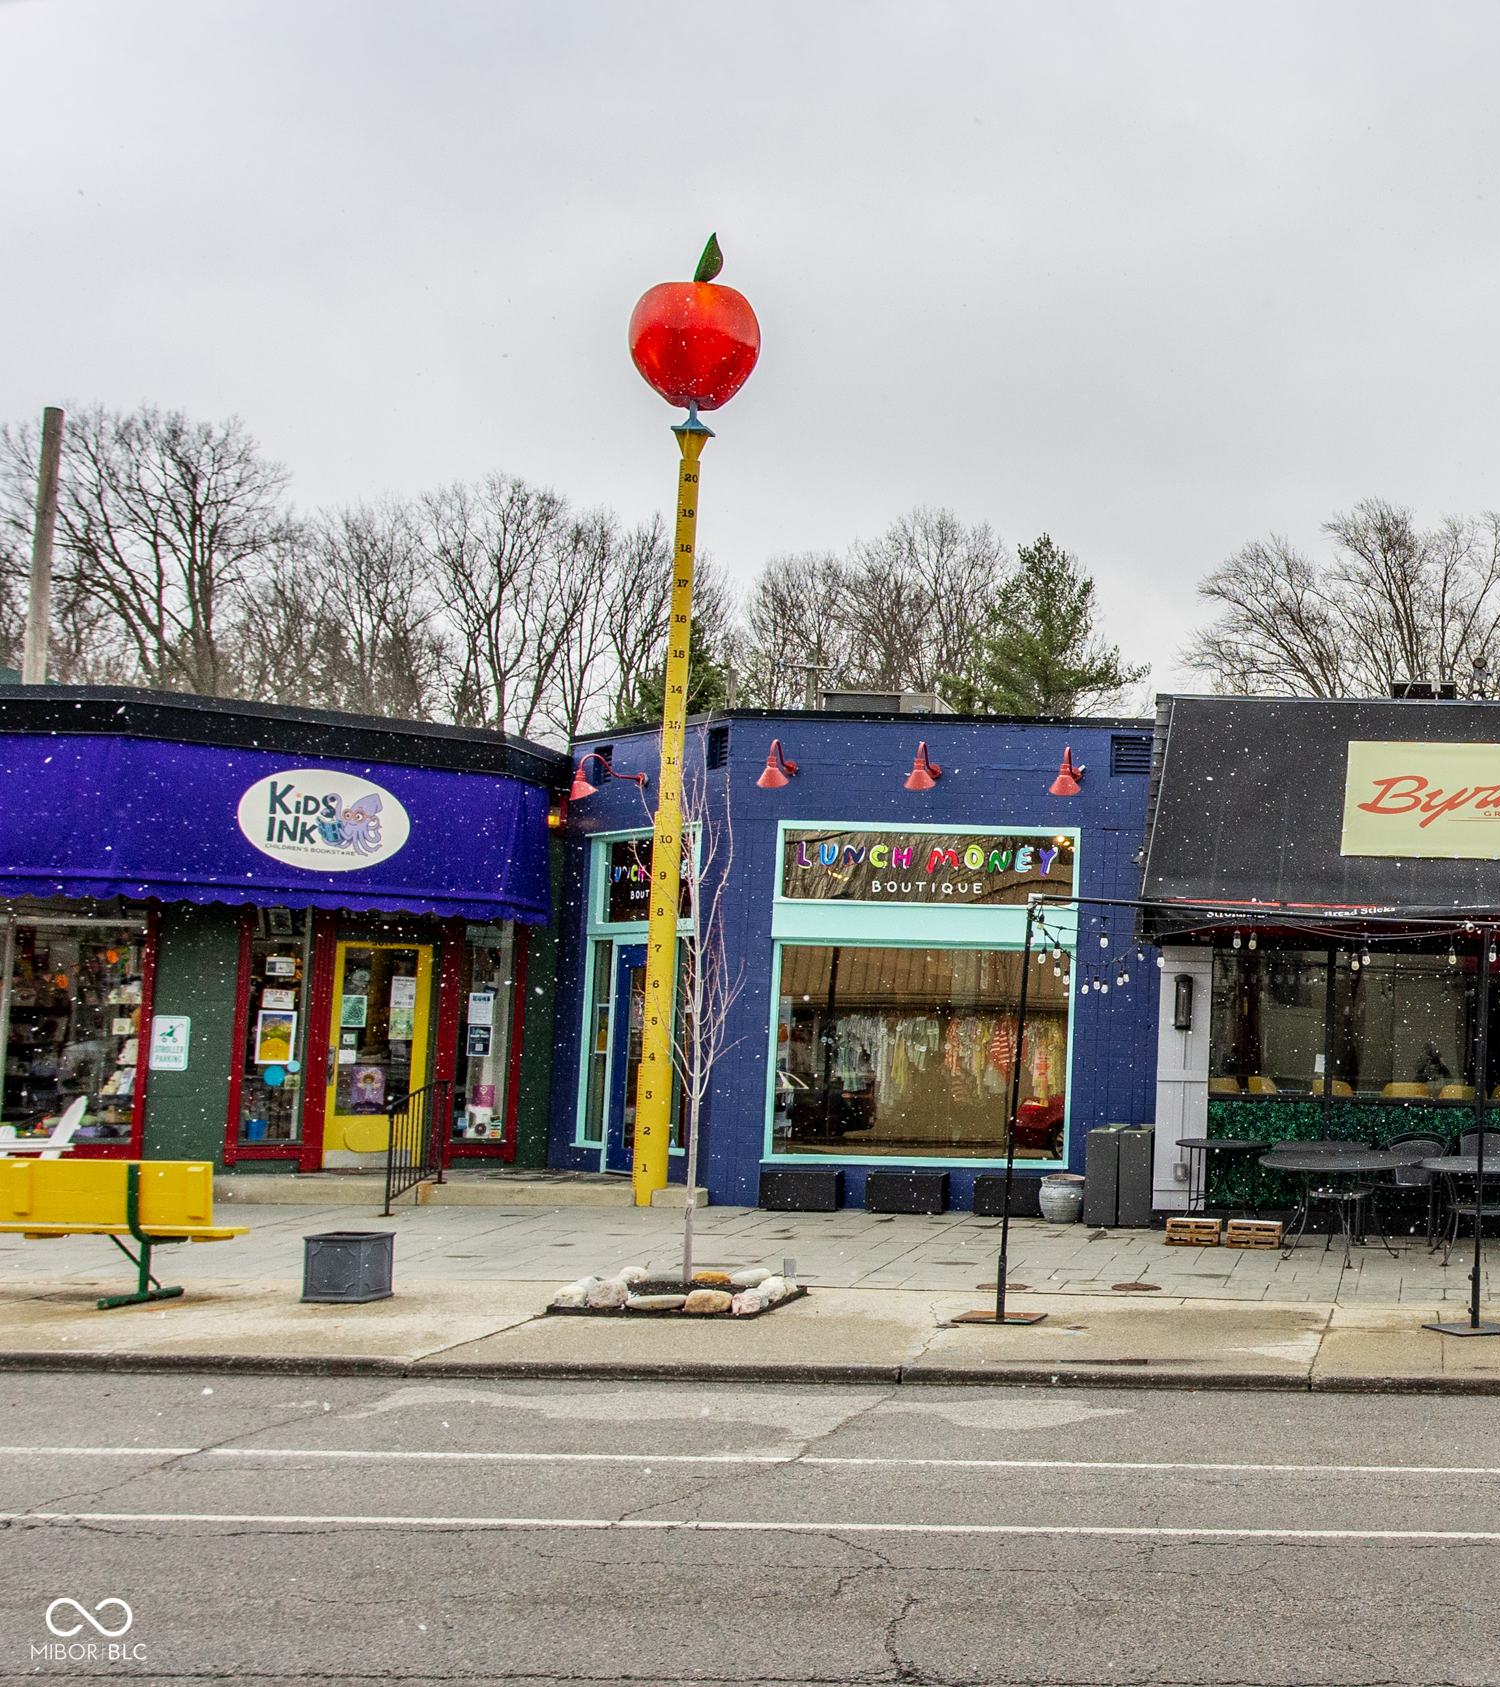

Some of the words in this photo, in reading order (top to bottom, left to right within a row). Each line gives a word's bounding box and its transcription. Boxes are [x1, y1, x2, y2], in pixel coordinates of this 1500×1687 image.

[684, 473, 698, 484] 20
[682, 508, 694, 518] 19
[679, 543, 692, 553] 18
[677, 579, 688, 588] 17
[675, 614, 687, 623] 16
[673, 649, 685, 658] 15
[670, 685, 683, 694] 14
[664, 791, 675, 801] 11
[266, 816, 318, 844] INK
[660, 835, 672, 844] 10
[265, 843, 309, 852] CHILDREN'S
[797, 841, 914, 869] LUNCH
[926, 844, 1058, 876] MONEY
[659, 871, 667, 880] 9
[871, 880, 983, 895] BOUTIQUE
[630, 889, 650, 900] BOUT
[656, 907, 664, 917] 8
[1360, 906, 1396, 915] Sticks
[654, 944, 662, 953] 7
[652, 979, 660, 988] 6
[269, 989, 290, 997] OPEN
[650, 1016, 658, 1026] 5
[154, 1045, 184, 1054] STROLLER
[155, 1055, 182, 1063] PARKING
[648, 1052, 656, 1061] 4
[645, 1090, 653, 1100] 3
[643, 1126, 651, 1136] 2
[641, 1163, 648, 1173] 1
